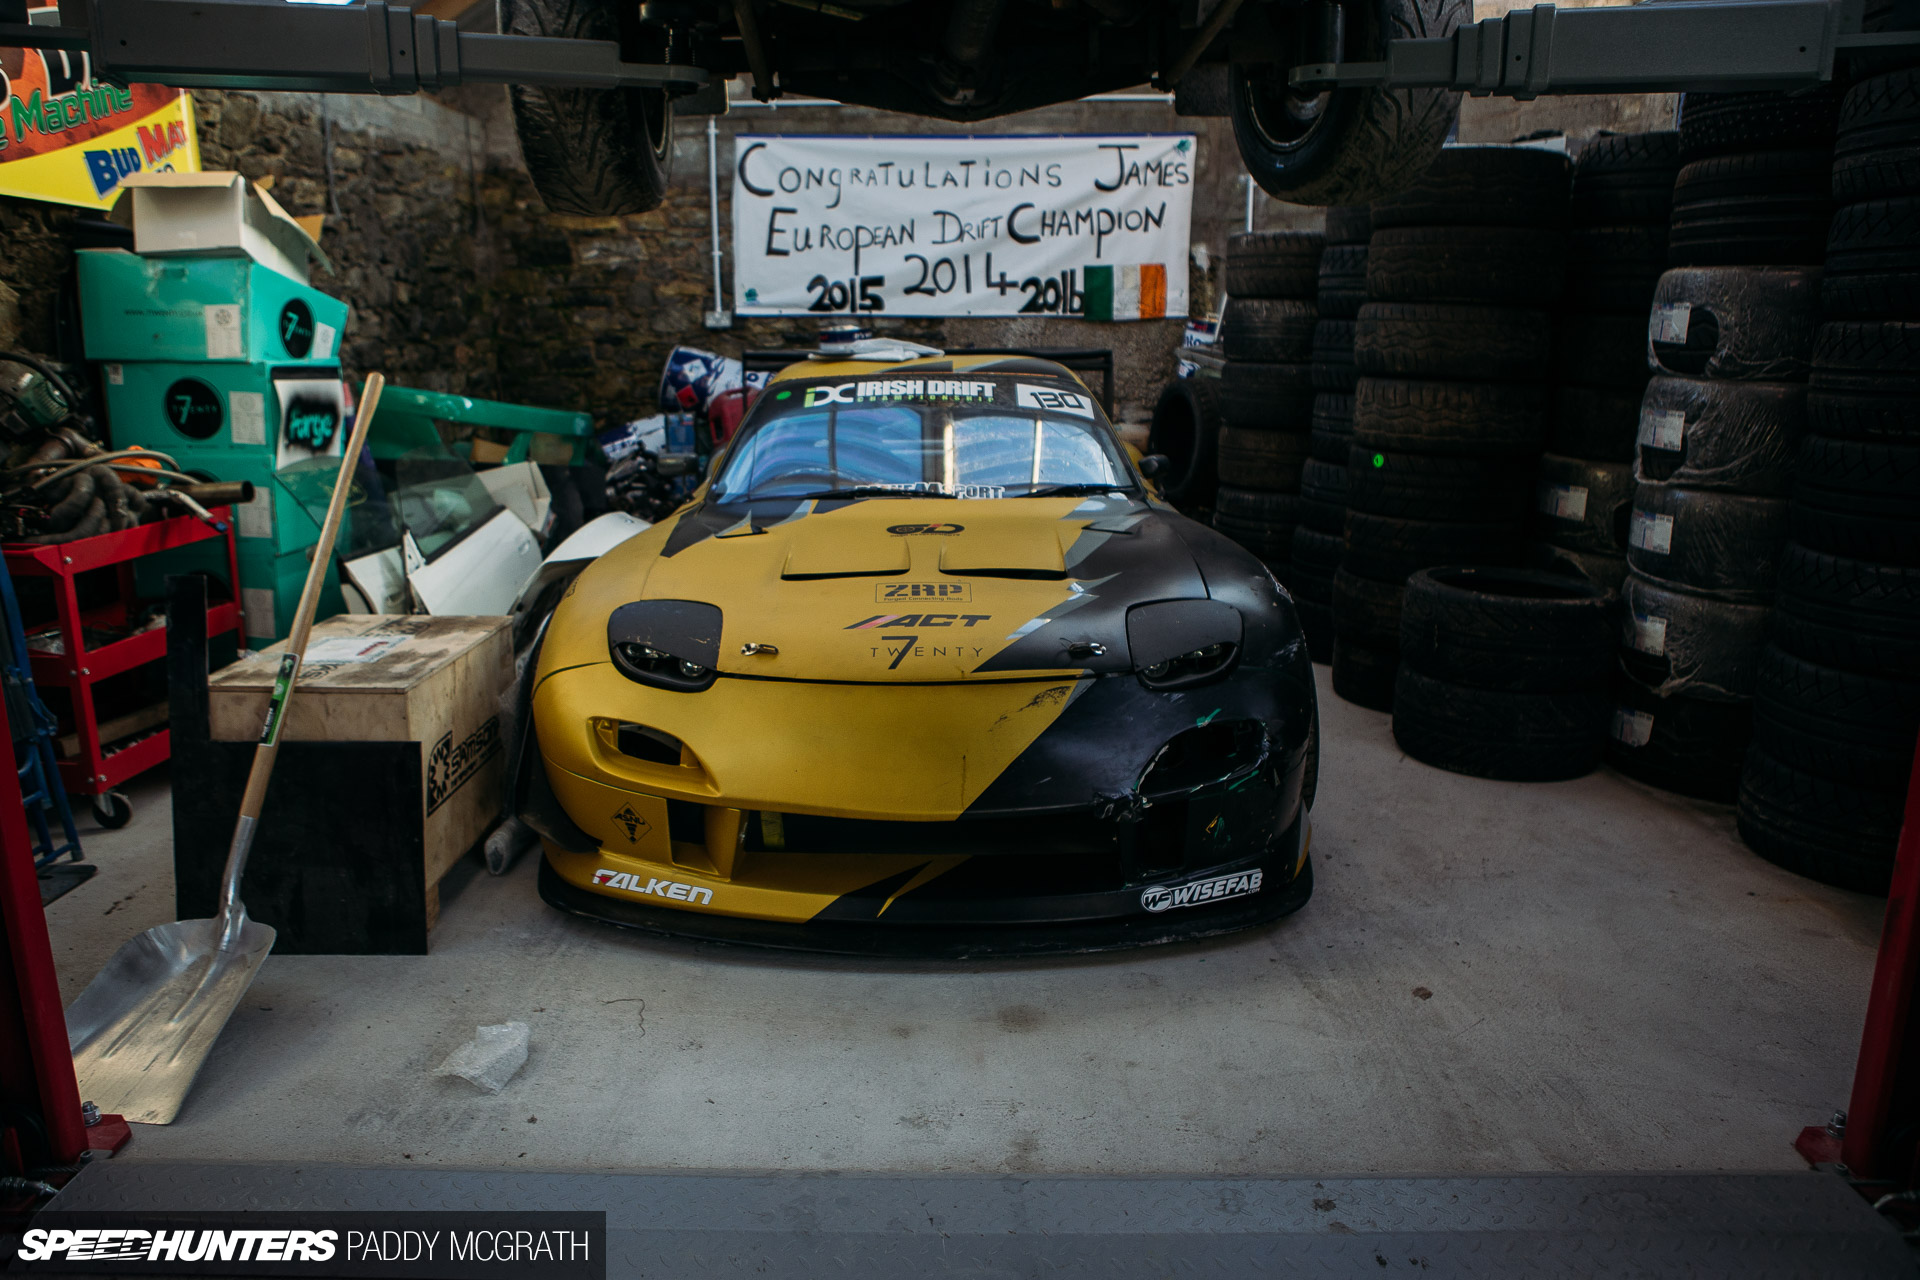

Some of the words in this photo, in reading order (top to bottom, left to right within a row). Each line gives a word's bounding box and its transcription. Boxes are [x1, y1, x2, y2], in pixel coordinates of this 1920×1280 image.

[10, 77, 134, 143] Machine
[83, 146, 142, 200] BUD
[136, 120, 187, 168] MAT
[1095, 144, 1190, 192] JAMES
[931, 210, 1004, 244] DRIFT
[806, 274, 885, 314] 2015
[903, 252, 1020, 297] 2014
[857, 380, 924, 397] IRISH
[927, 380, 997, 397] DRIFT
[857, 394, 995, 403] CHAMPIONSHIP
[1030, 391, 1085, 409] 130
[884, 584, 963, 597] ZRP
[876, 614, 992, 628] ACT
[613, 813, 647, 826] ASNU
[592, 868, 714, 905] FALKEN
[1174, 872, 1263, 905] WISEFAB
